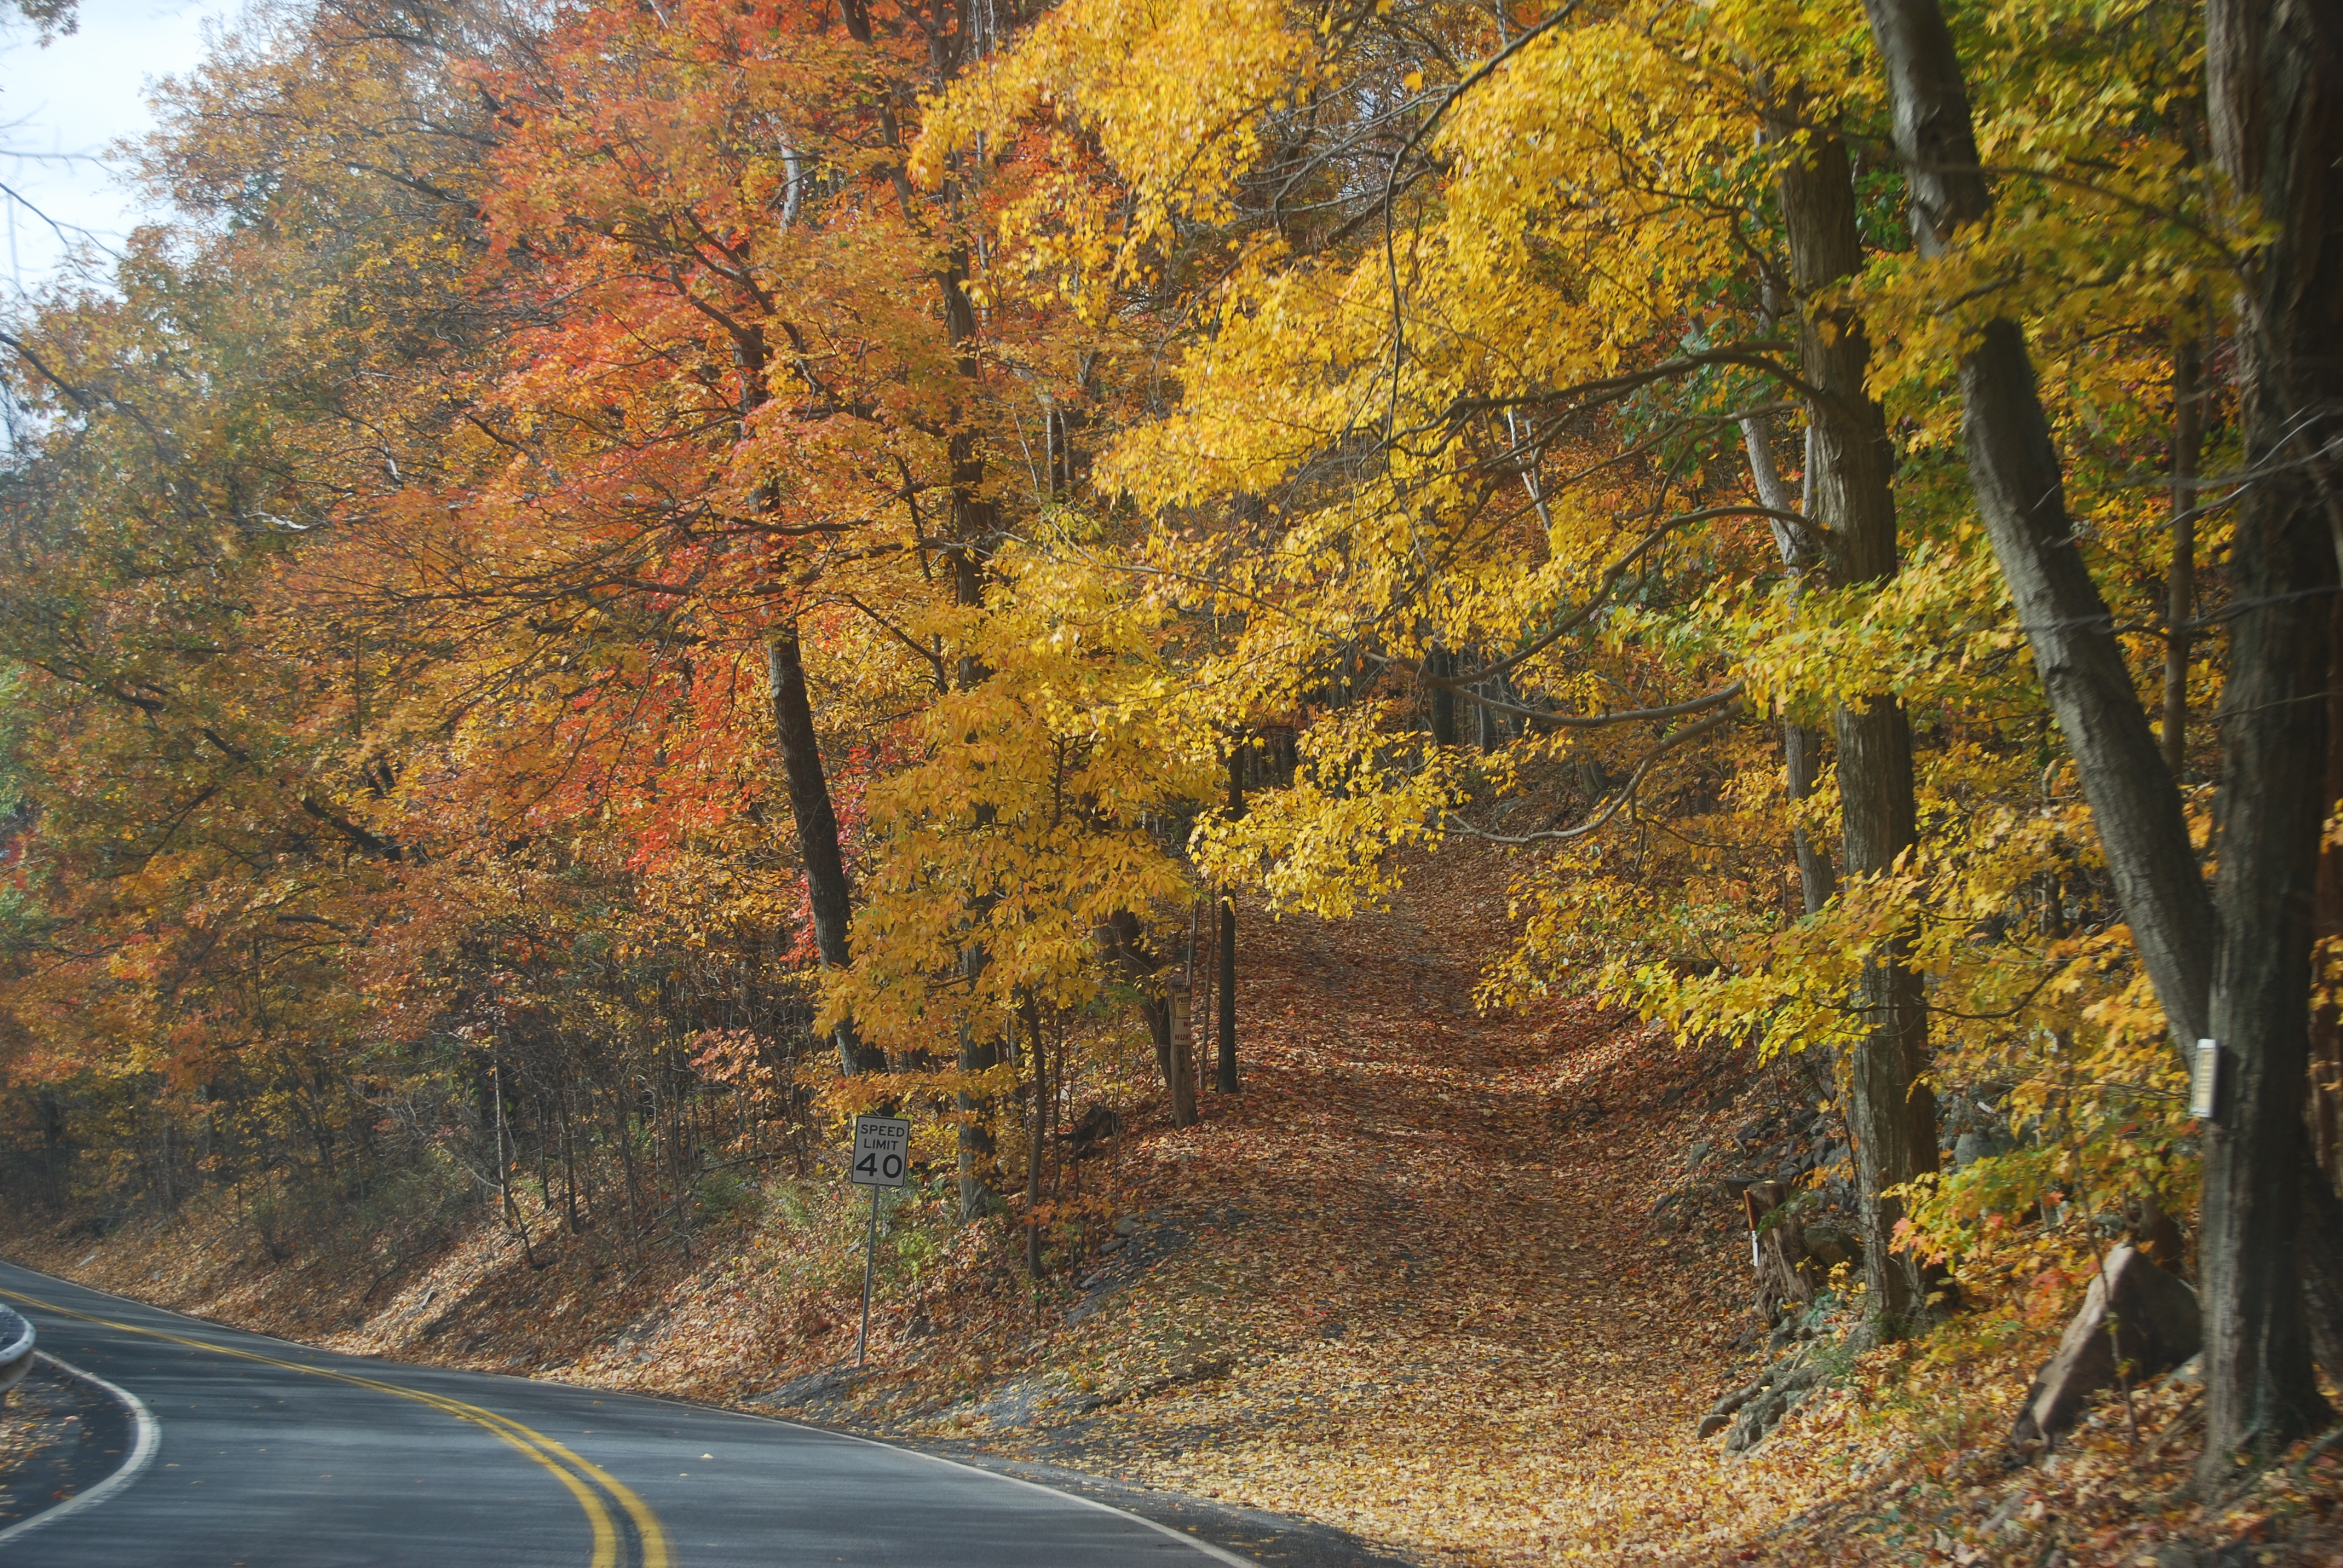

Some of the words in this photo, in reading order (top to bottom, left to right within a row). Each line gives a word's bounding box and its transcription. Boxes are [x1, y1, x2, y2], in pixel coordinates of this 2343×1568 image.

[860, 1124, 905, 1137] SPEED
[863, 1138, 899, 1151] LIMIT
[856, 1152, 902, 1178] 40
